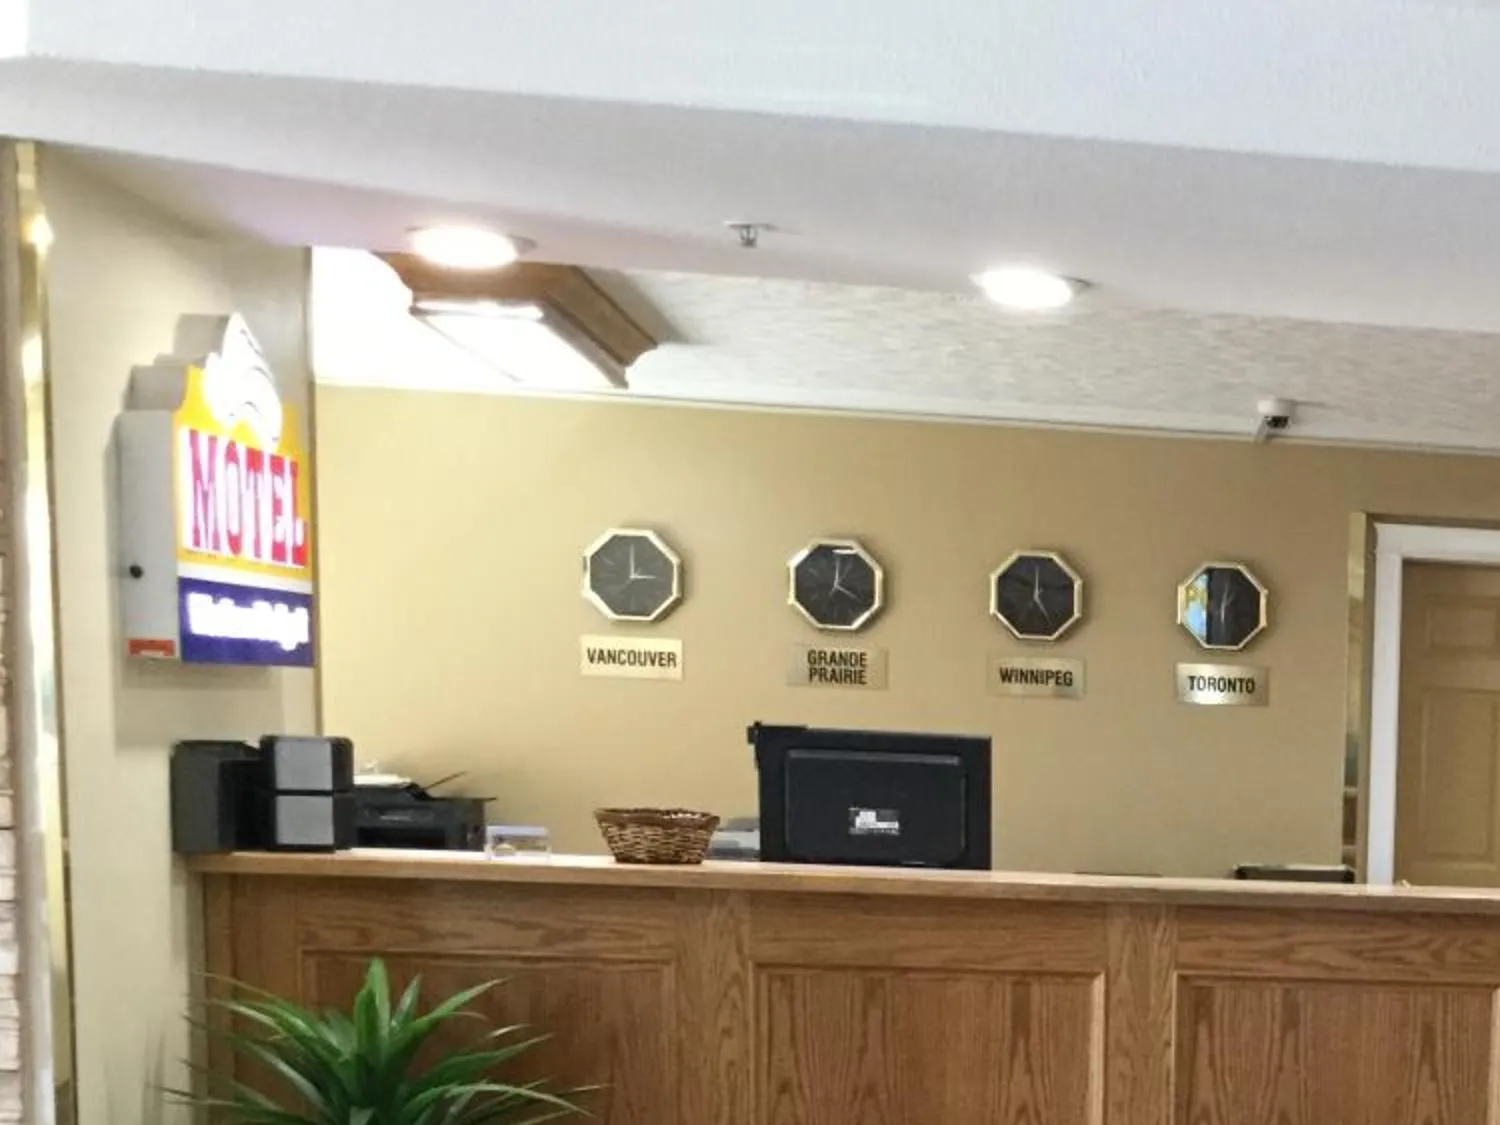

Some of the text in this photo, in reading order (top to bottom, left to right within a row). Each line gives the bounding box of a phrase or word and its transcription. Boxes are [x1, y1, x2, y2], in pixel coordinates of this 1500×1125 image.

[187, 427, 308, 567] MOTEL
[587, 647, 677, 668] VANCOUVER
[807, 650, 867, 667] GRANDE
[808, 667, 867, 685] PRAIRIE
[1000, 667, 1073, 687] WINNIPEG
[1188, 675, 1256, 694] TORONTO
